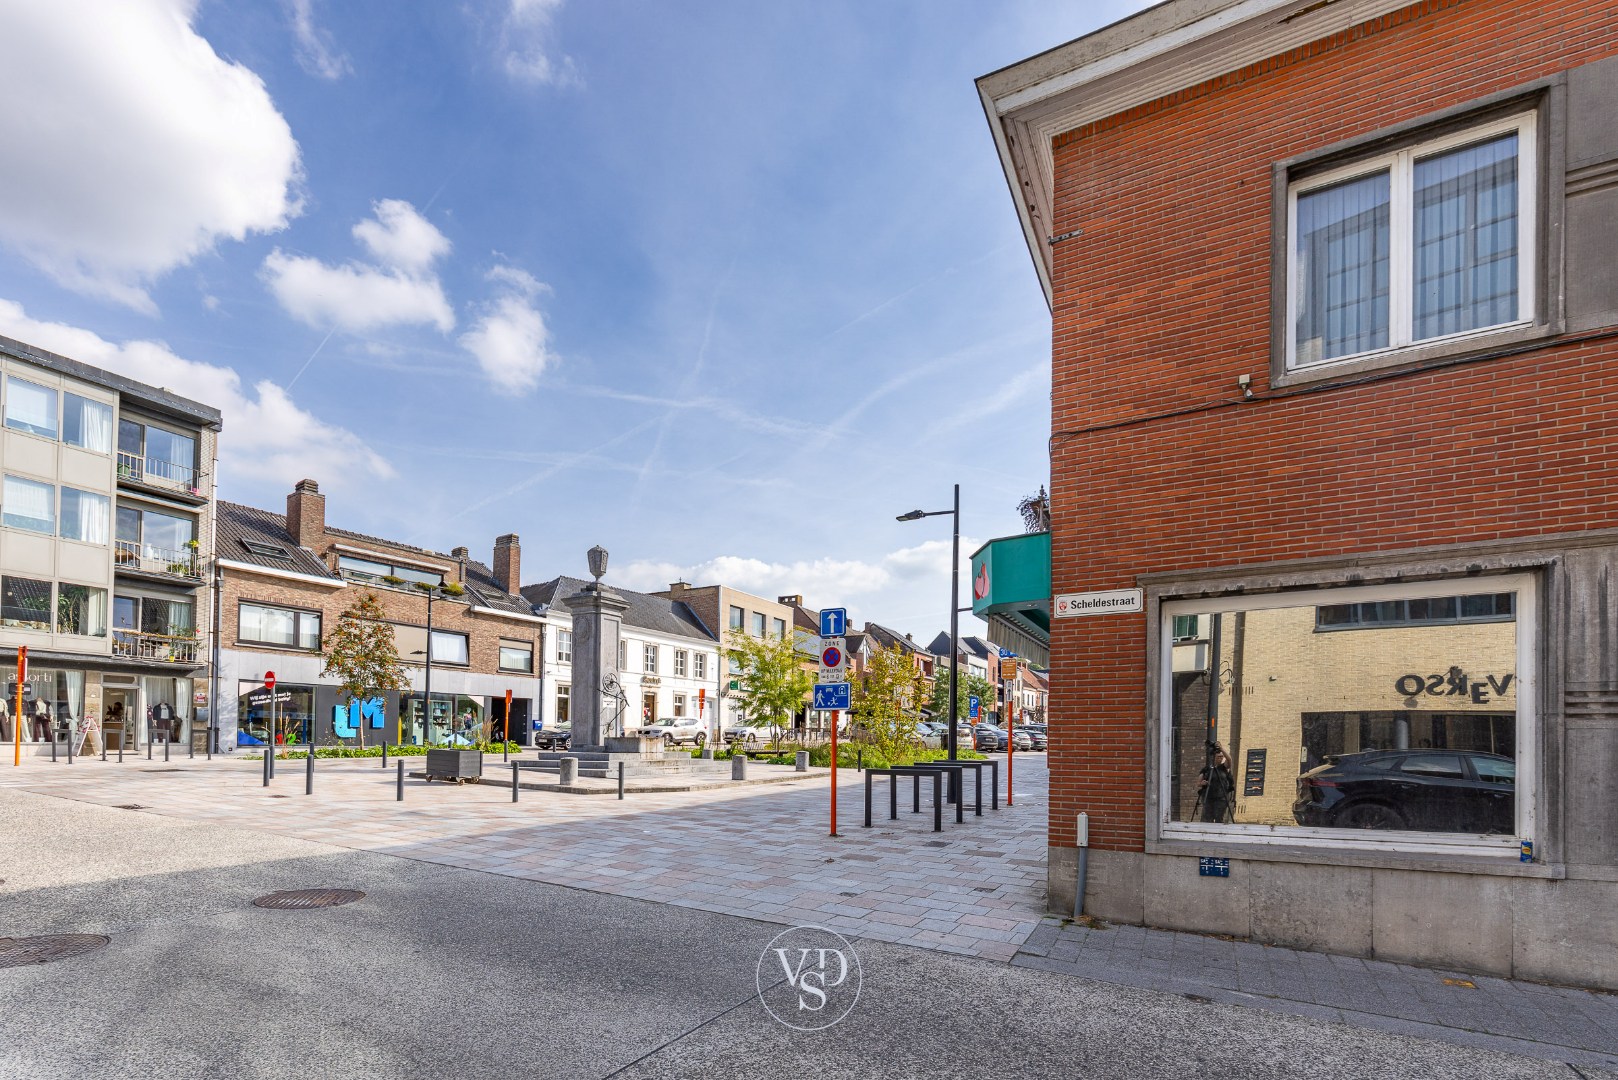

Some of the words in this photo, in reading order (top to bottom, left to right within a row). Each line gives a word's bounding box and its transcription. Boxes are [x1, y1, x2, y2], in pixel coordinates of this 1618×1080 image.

[1070, 597, 1135, 609] Scheldestraat
[8, 672, 52, 683] aorti
[970, 698, 978, 708] P
